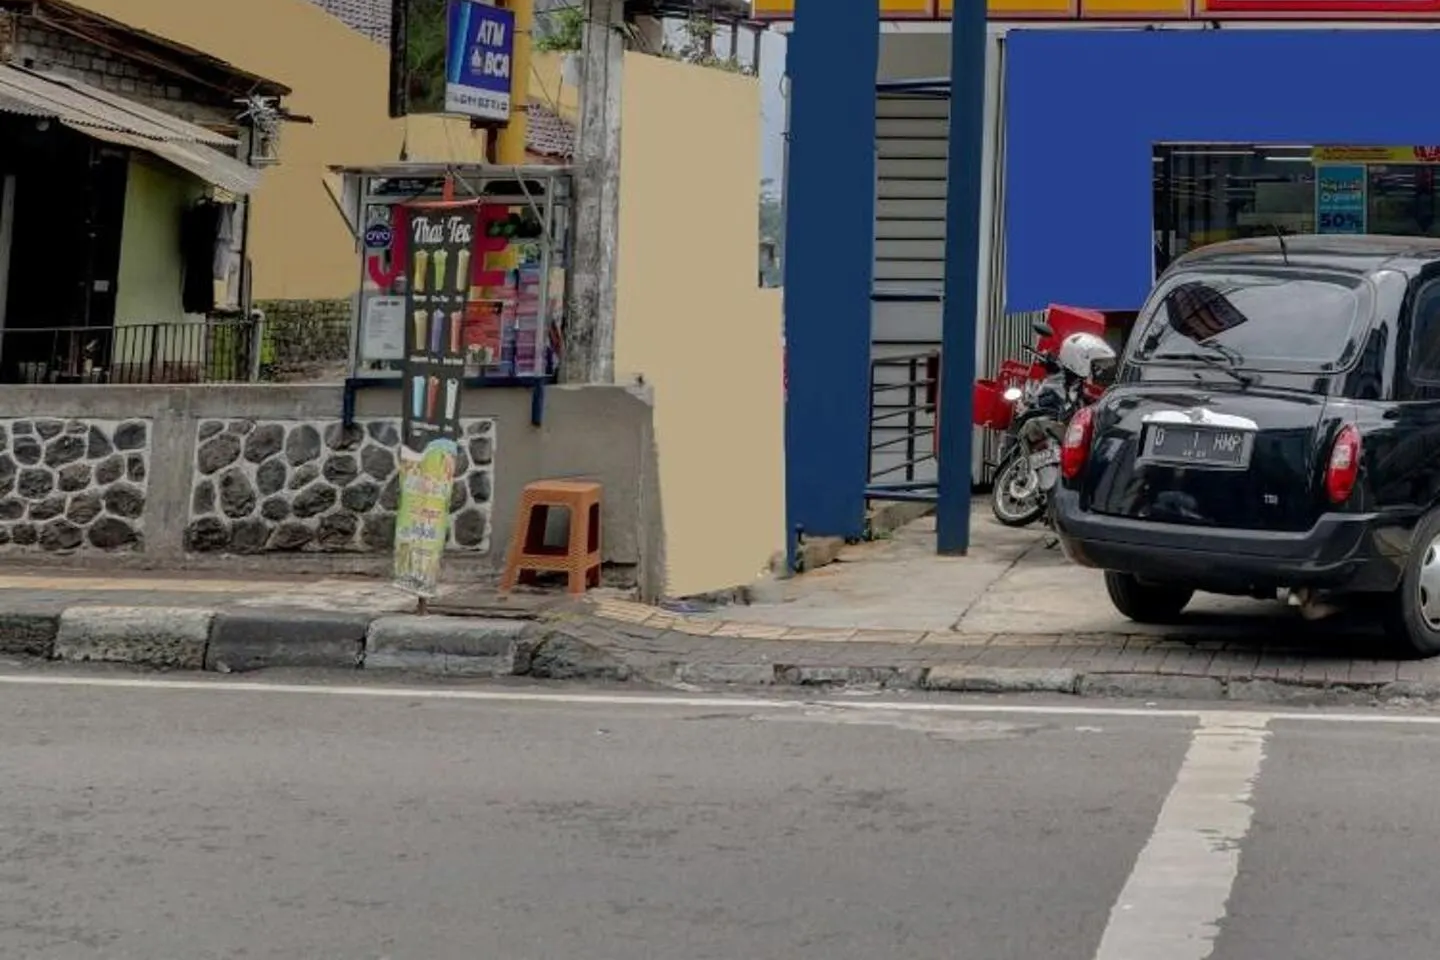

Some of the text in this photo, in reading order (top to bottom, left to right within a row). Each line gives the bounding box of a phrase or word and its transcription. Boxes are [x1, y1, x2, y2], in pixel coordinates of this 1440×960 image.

[476, 18, 506, 47] ATM
[484, 51, 510, 78] BCA
[412, 216, 473, 243] Thai Tea
